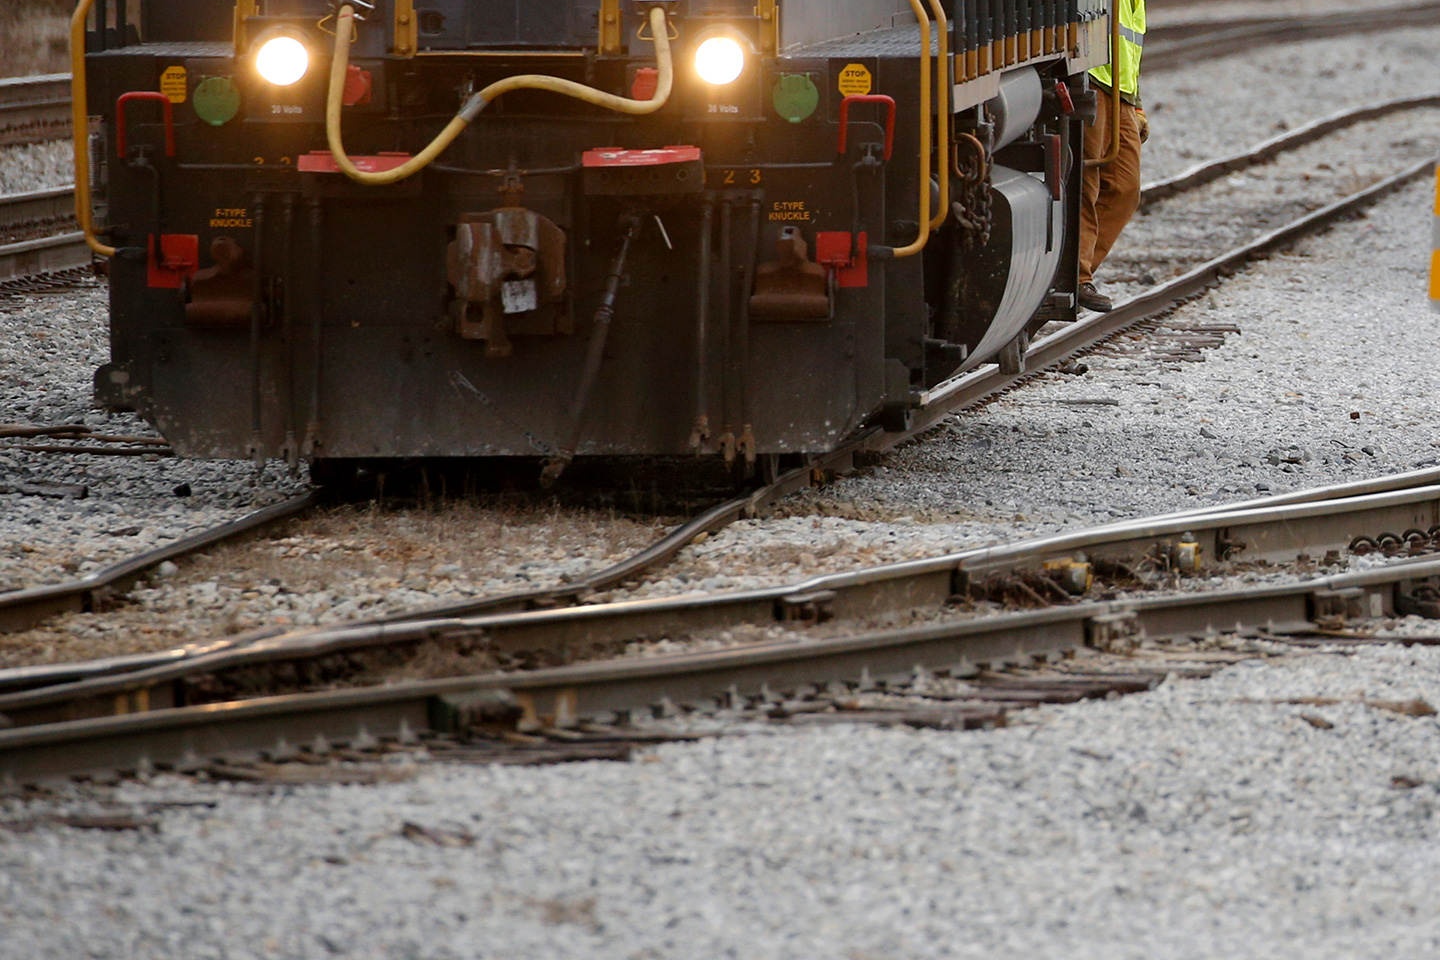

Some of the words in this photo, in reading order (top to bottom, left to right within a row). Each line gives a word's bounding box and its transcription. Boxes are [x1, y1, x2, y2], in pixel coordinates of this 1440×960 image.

[845, 70, 866, 78] STOP
[723, 169, 736, 184] 2
[750, 169, 761, 184] 3
[773, 201, 804, 210] E-TYPE
[768, 211, 810, 220] KNUCKLE
[209, 218, 253, 228] KNUCKLE
